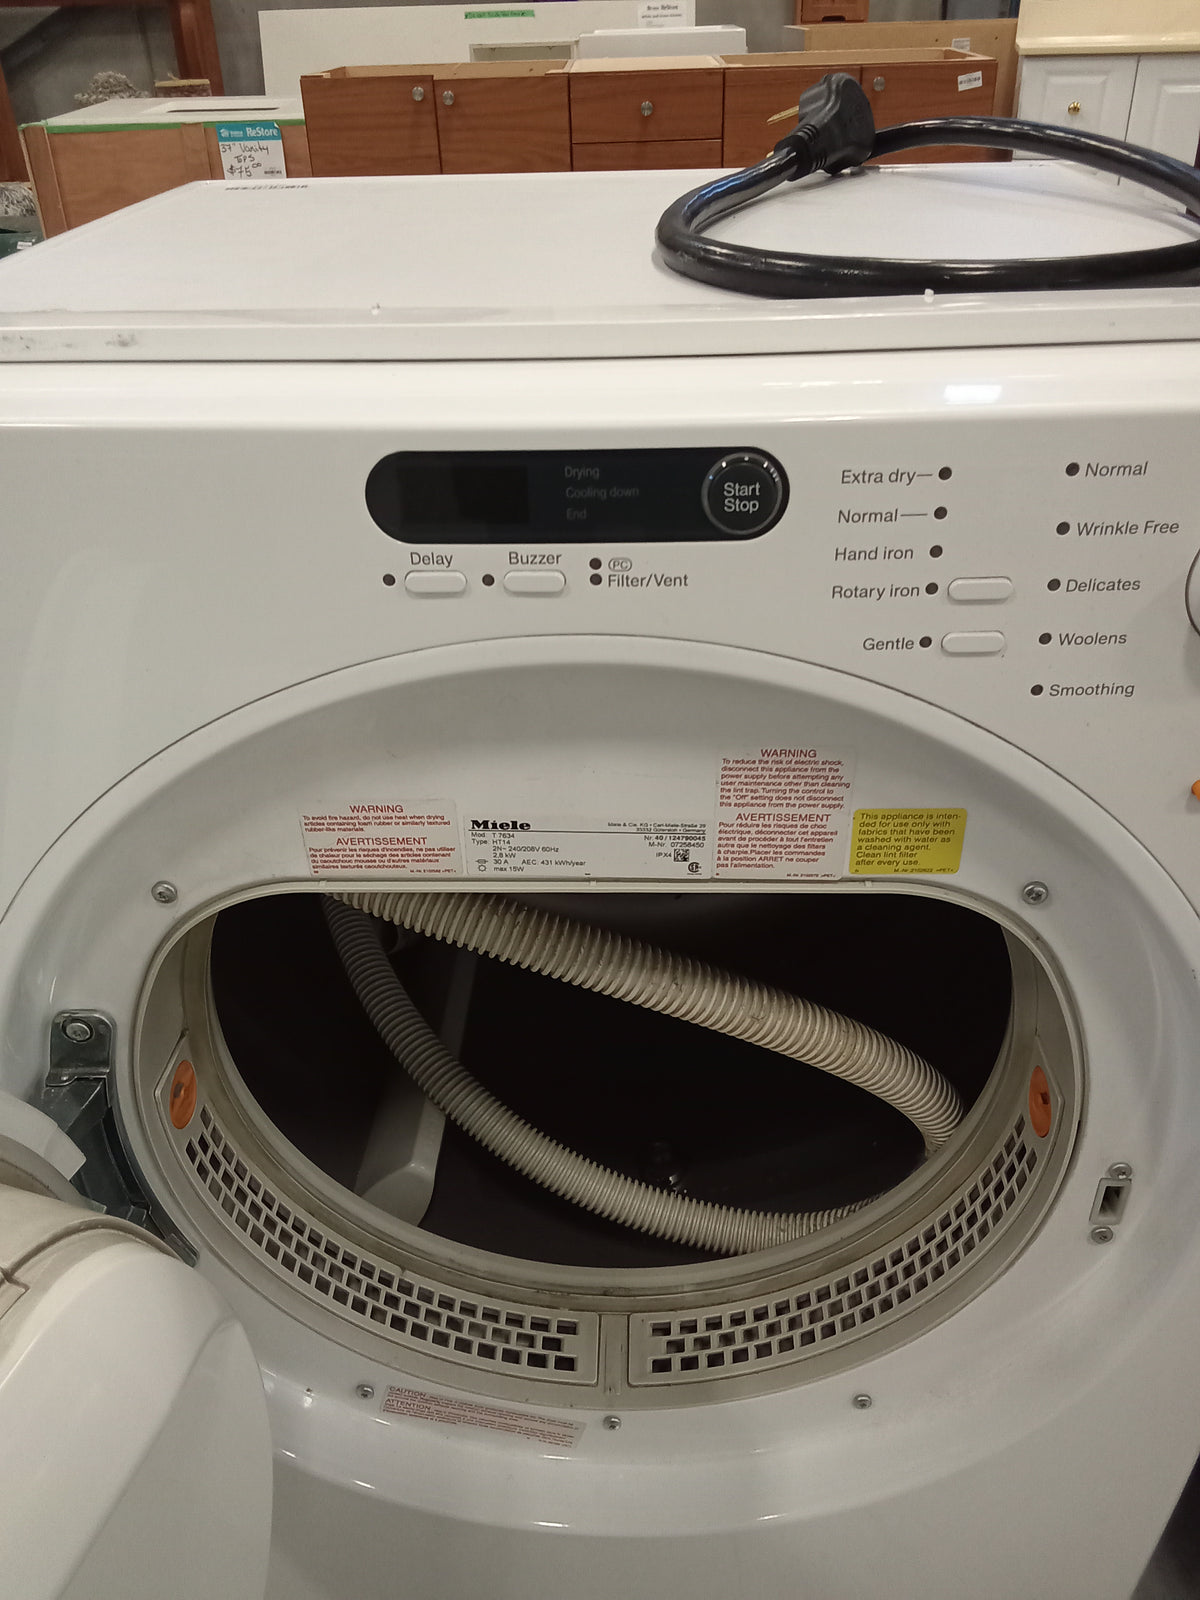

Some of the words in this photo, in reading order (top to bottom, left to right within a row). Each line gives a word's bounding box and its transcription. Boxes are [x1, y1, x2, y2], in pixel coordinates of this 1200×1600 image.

[246, 127, 278, 137] ReStore
[240, 141, 269, 155] Vanity
[564, 466, 600, 480] Drying
[1085, 462, 1148, 477] Normal
[841, 469, 883, 485] Extra
[888, 468, 916, 486] dry
[565, 486, 606, 501] Cooling
[609, 485, 640, 498] down
[724, 482, 760, 497] Start
[724, 498, 759, 513] Stop
[566, 507, 587, 520] End
[838, 509, 898, 524] Normal
[1077, 522, 1138, 536] Wrinkle
[1144, 521, 1179, 535] Free
[410, 552, 453, 568] Delay
[508, 552, 562, 566] Buzzer
[834, 548, 878, 561] Hand
[883, 547, 913, 560] iron
[607, 574, 688, 588] Filter/Vent
[1066, 578, 1141, 592] Delicates
[832, 584, 885, 601] Rotary
[890, 584, 920, 597] iron
[863, 637, 914, 651] Gentle
[1059, 632, 1127, 646] Woolens
[1049, 683, 1135, 697] Smoothing
[761, 749, 817, 758] WARNING
[350, 804, 404, 813] WARNING
[734, 801, 766, 809] appliance
[736, 813, 831, 822] AVERTISSEMENT
[881, 813, 924, 821] appliance
[471, 819, 531, 830] Miele
[912, 821, 930, 829] only
[336, 837, 427, 846] AVERTISSEMENT
[865, 844, 901, 852] cleaning
[856, 851, 881, 859] Clean
[884, 851, 897, 859] lint
[877, 859, 900, 867] every
[389, 1386, 426, 1398] CAUTION
[385, 1398, 431, 1411] ATTENTION
